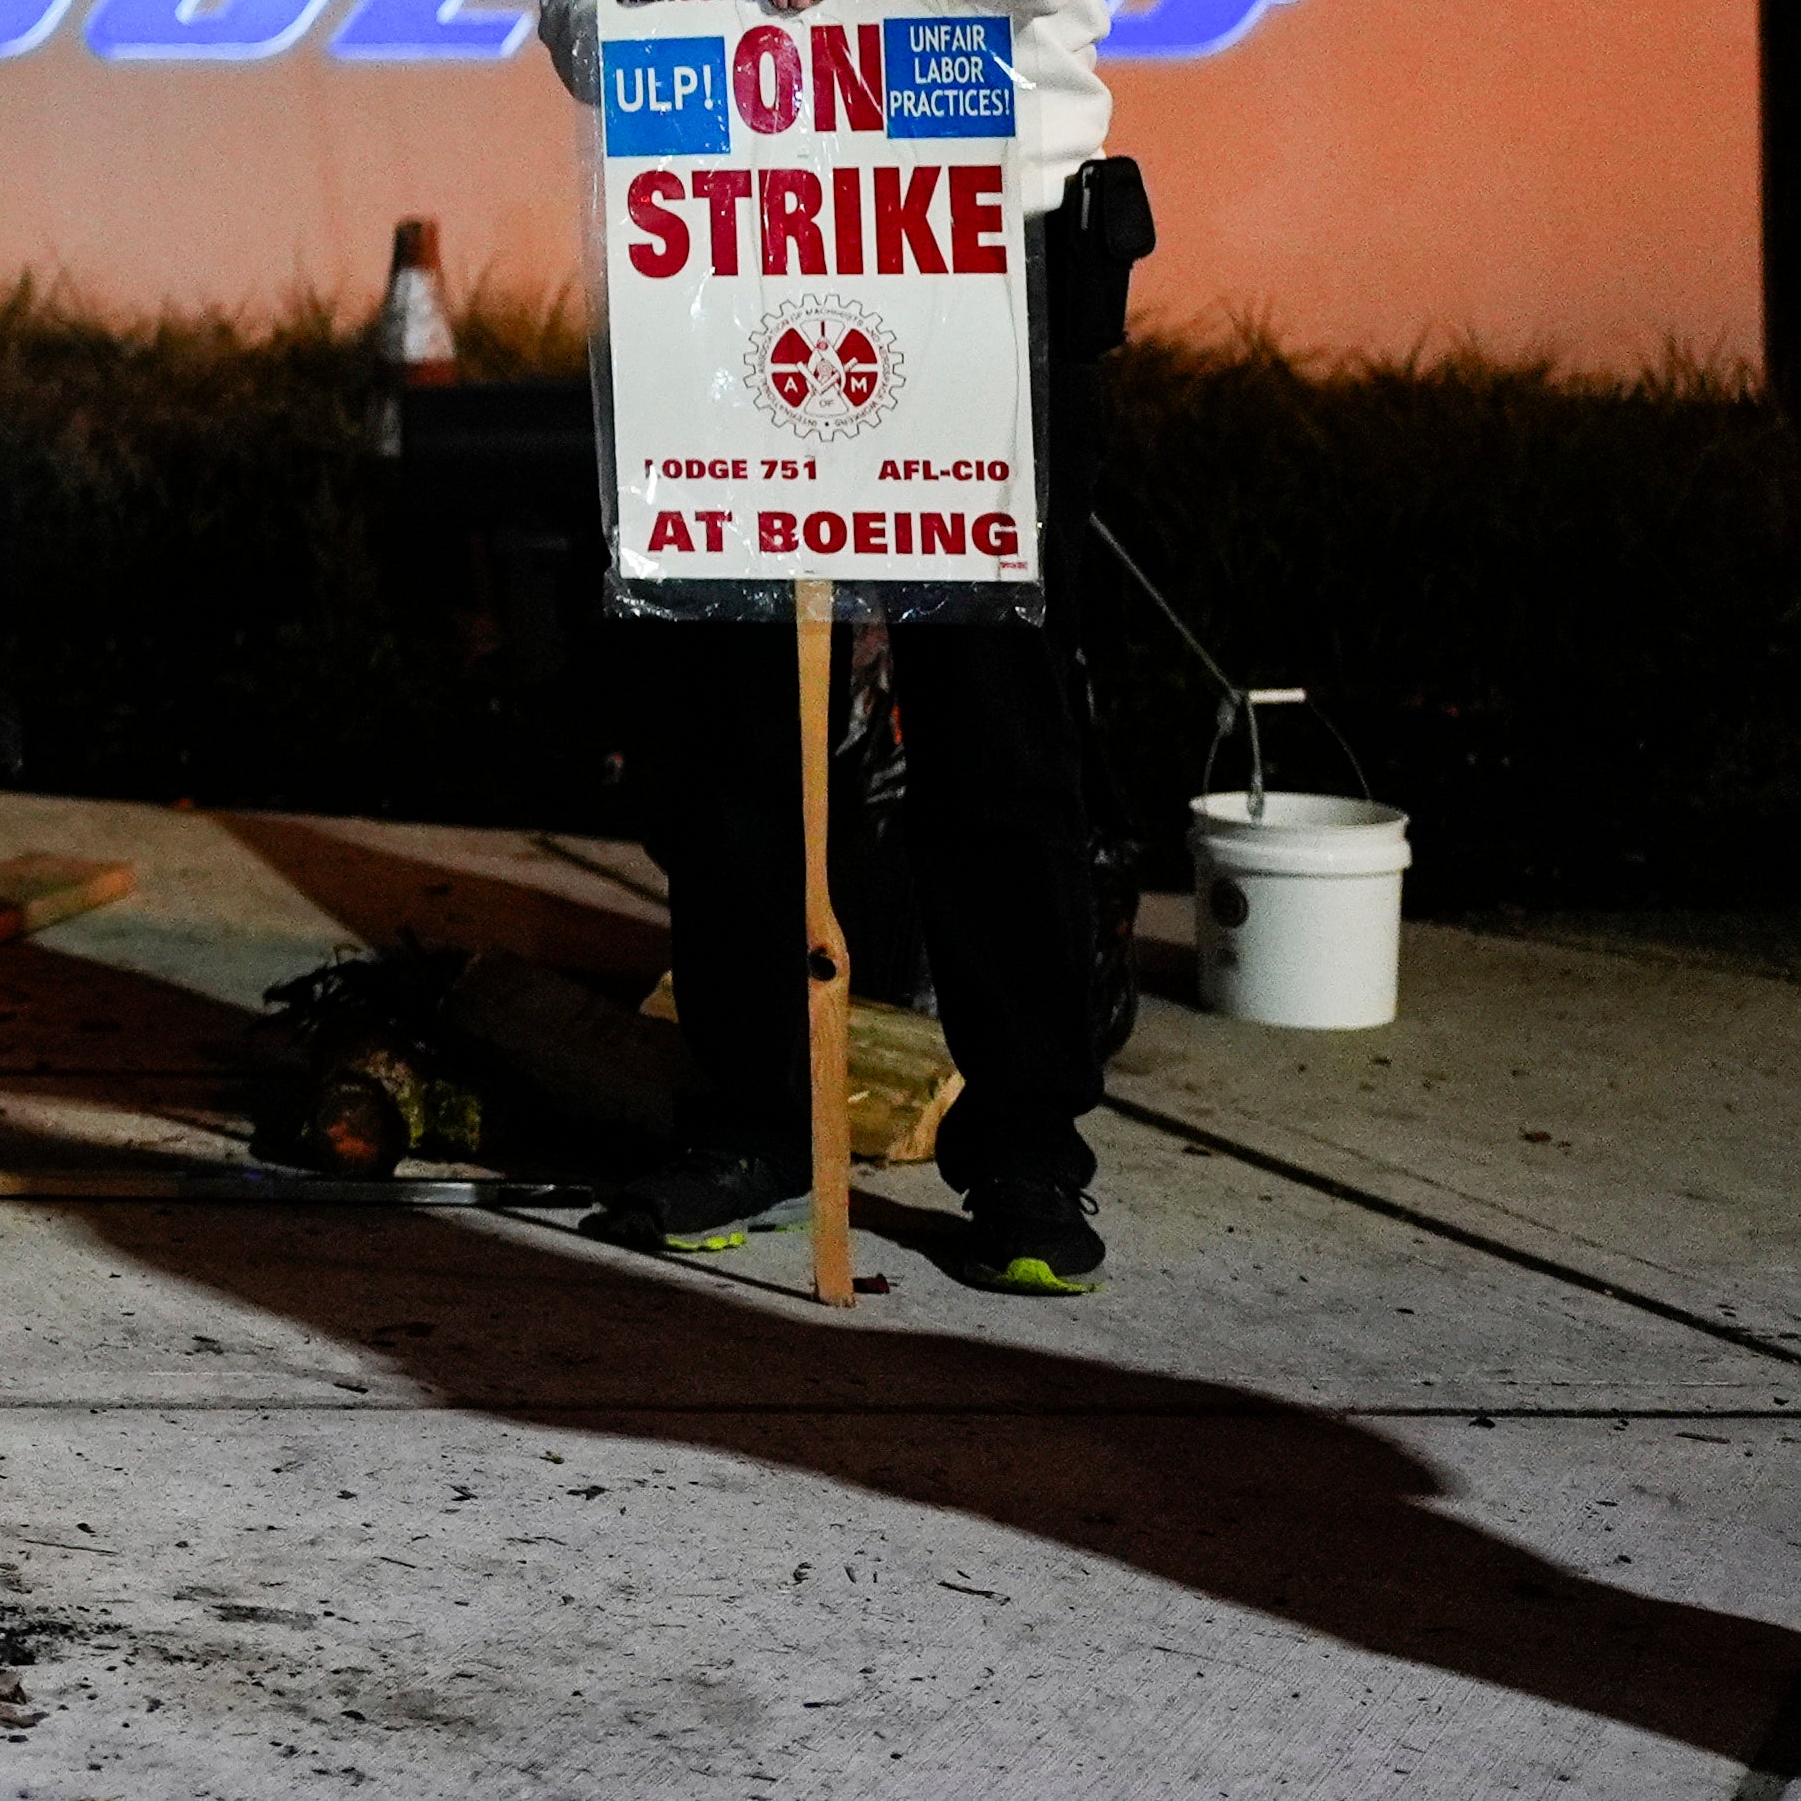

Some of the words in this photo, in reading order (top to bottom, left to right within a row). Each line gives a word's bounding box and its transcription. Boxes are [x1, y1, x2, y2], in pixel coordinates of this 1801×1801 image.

[910, 24, 987, 52] UNFAIR
[733, 24, 884, 134] ON
[914, 57, 984, 84] LABOR
[616, 64, 713, 112] ULP!
[889, 89, 1010, 117] PRACTICES!
[627, 165, 1007, 278] STRIKE
[760, 458, 817, 480] 751
[878, 459, 1010, 481] AFL-CIO
[648, 510, 733, 552] AT
[757, 511, 1019, 556] BOEING
